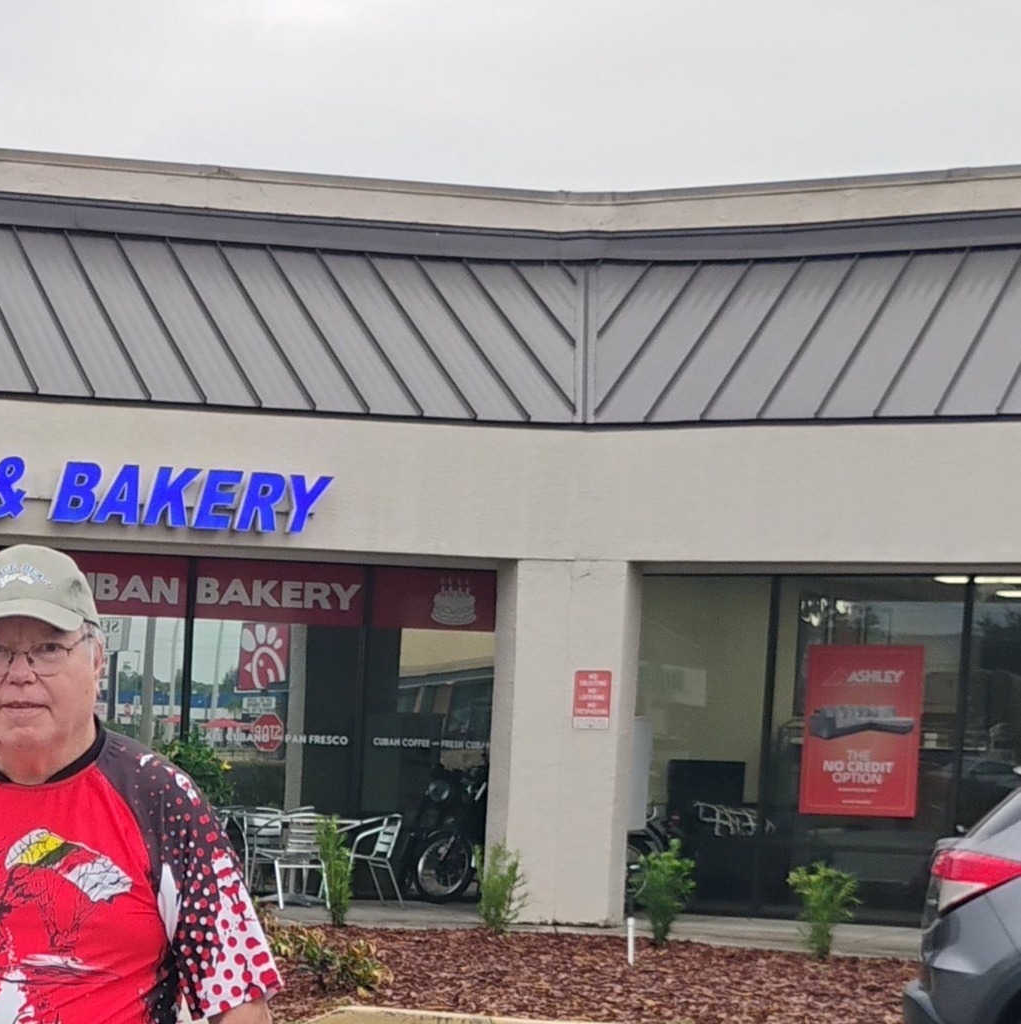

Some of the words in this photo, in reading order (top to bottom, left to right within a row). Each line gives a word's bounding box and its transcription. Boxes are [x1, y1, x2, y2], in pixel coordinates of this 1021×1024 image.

[48, 461, 334, 534] BAKERY
[196, 577, 362, 612] BAKERY
[847, 669, 905, 684] ASHLEY
[285, 734, 307, 744] PAN
[308, 734, 349, 746] FRESCO
[401, 738, 430, 748] COFFEE
[846, 750, 872, 761] THE
[823, 761, 846, 772] NO
[847, 761, 894, 774] CREDIT
[832, 772, 882, 785] OPTION
